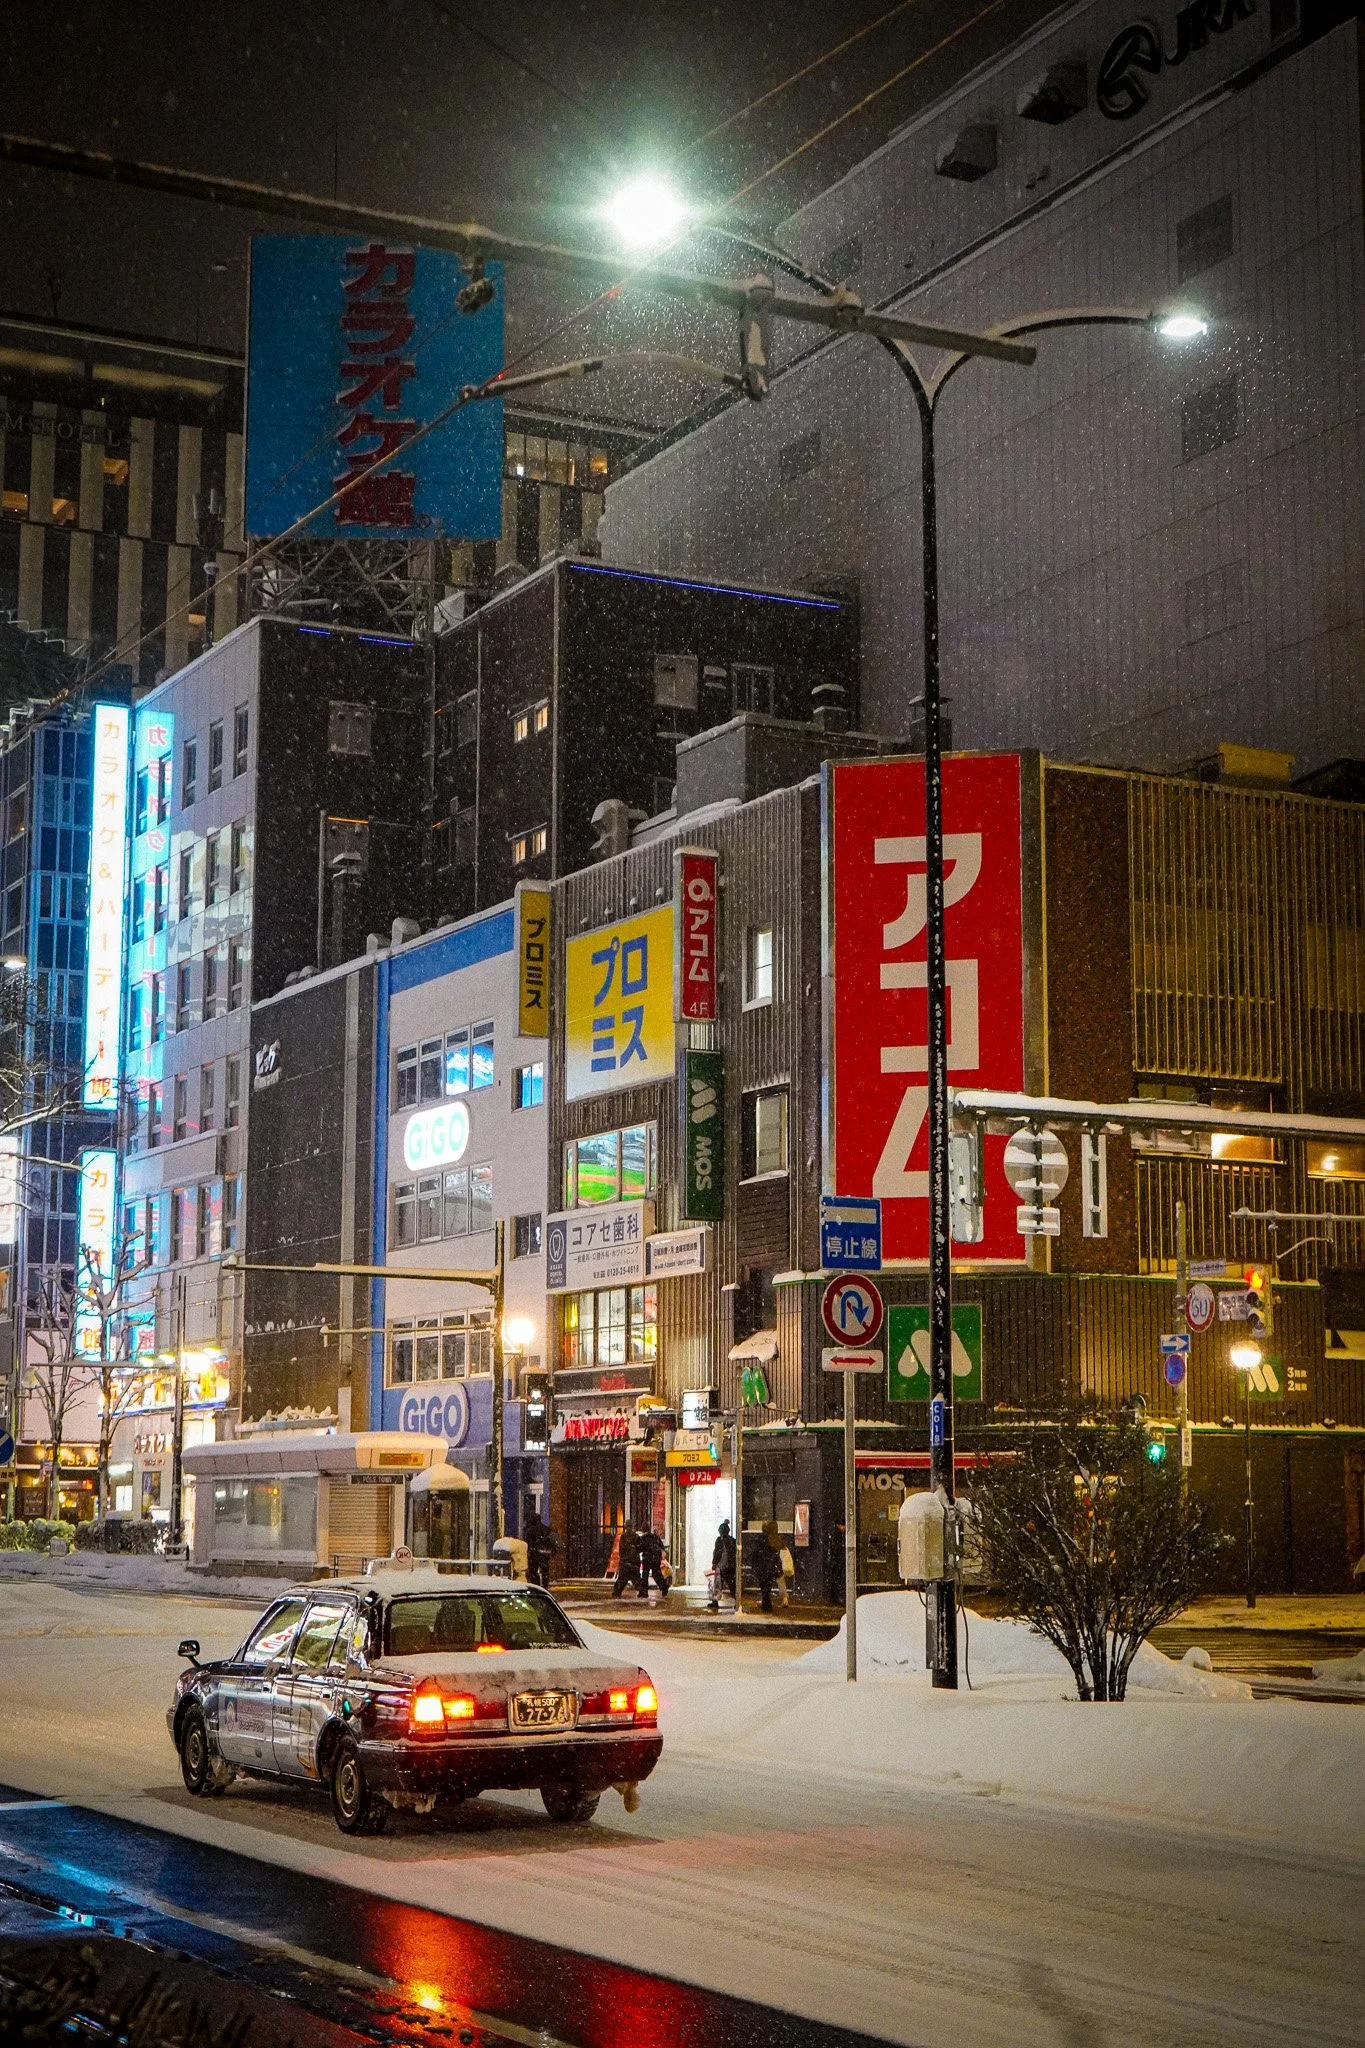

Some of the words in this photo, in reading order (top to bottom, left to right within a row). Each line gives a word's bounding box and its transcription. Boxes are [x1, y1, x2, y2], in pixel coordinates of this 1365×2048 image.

[333, 243, 416, 527] カラオケ館
[525, 918, 546, 1010] プロミス
[689, 1001, 709, 1016] 4F
[695, 1135, 712, 1191] MOS
[572, 1213, 639, 1246] コアセ歯科
[826, 1236, 878, 1260] 停止線
[1191, 1298, 1208, 1318] 50
[682, 1453, 700, 1463] プロミス
[857, 1473, 906, 1490] MOS
[526, 1707, 565, 1724] 27-26
